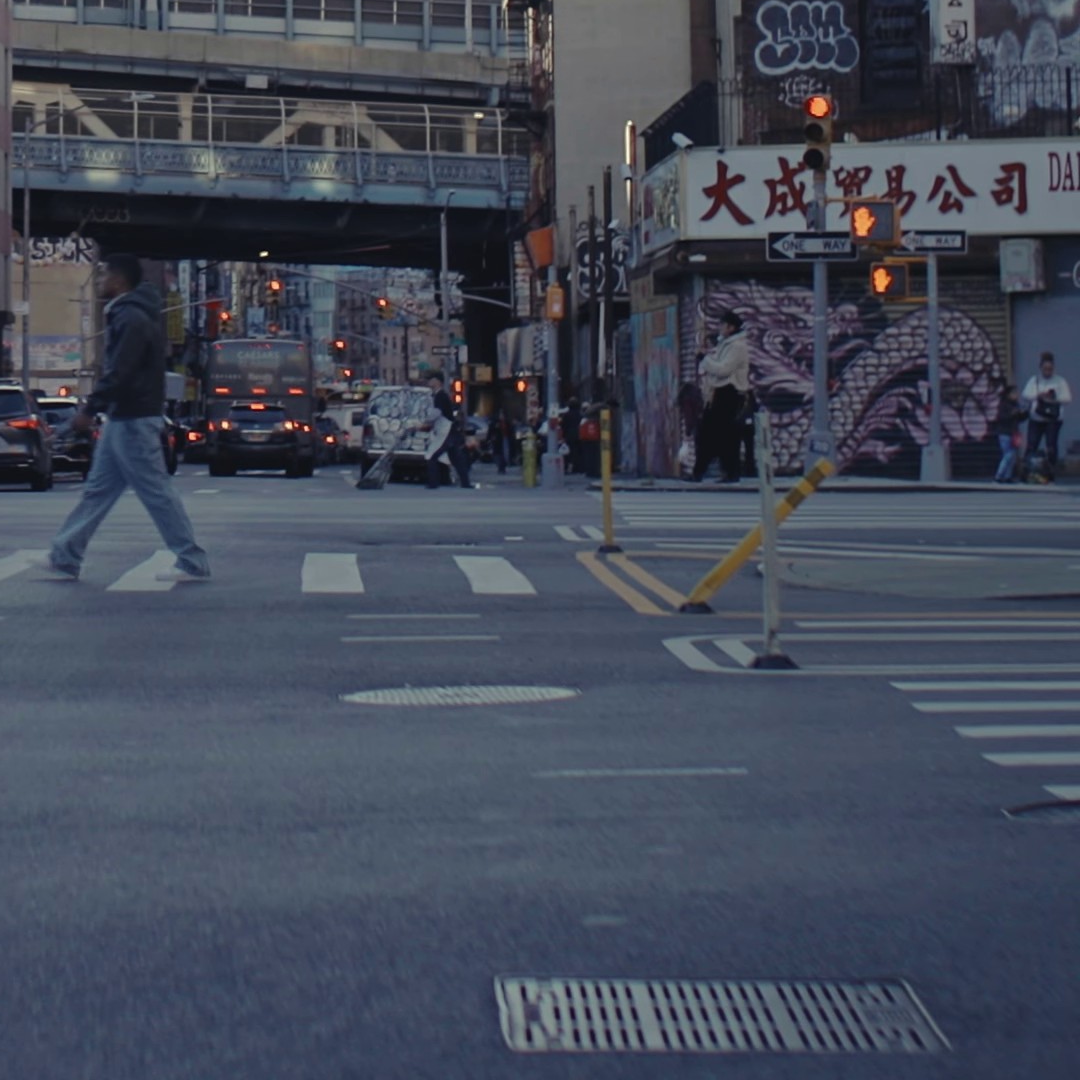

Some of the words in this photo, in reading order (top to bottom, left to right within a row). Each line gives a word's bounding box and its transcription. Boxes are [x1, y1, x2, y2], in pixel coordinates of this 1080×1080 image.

[782, 238, 806, 252] ONE
[823, 238, 848, 251] WAY
[905, 235, 925, 247] ONE
[935, 235, 957, 246] WAY
